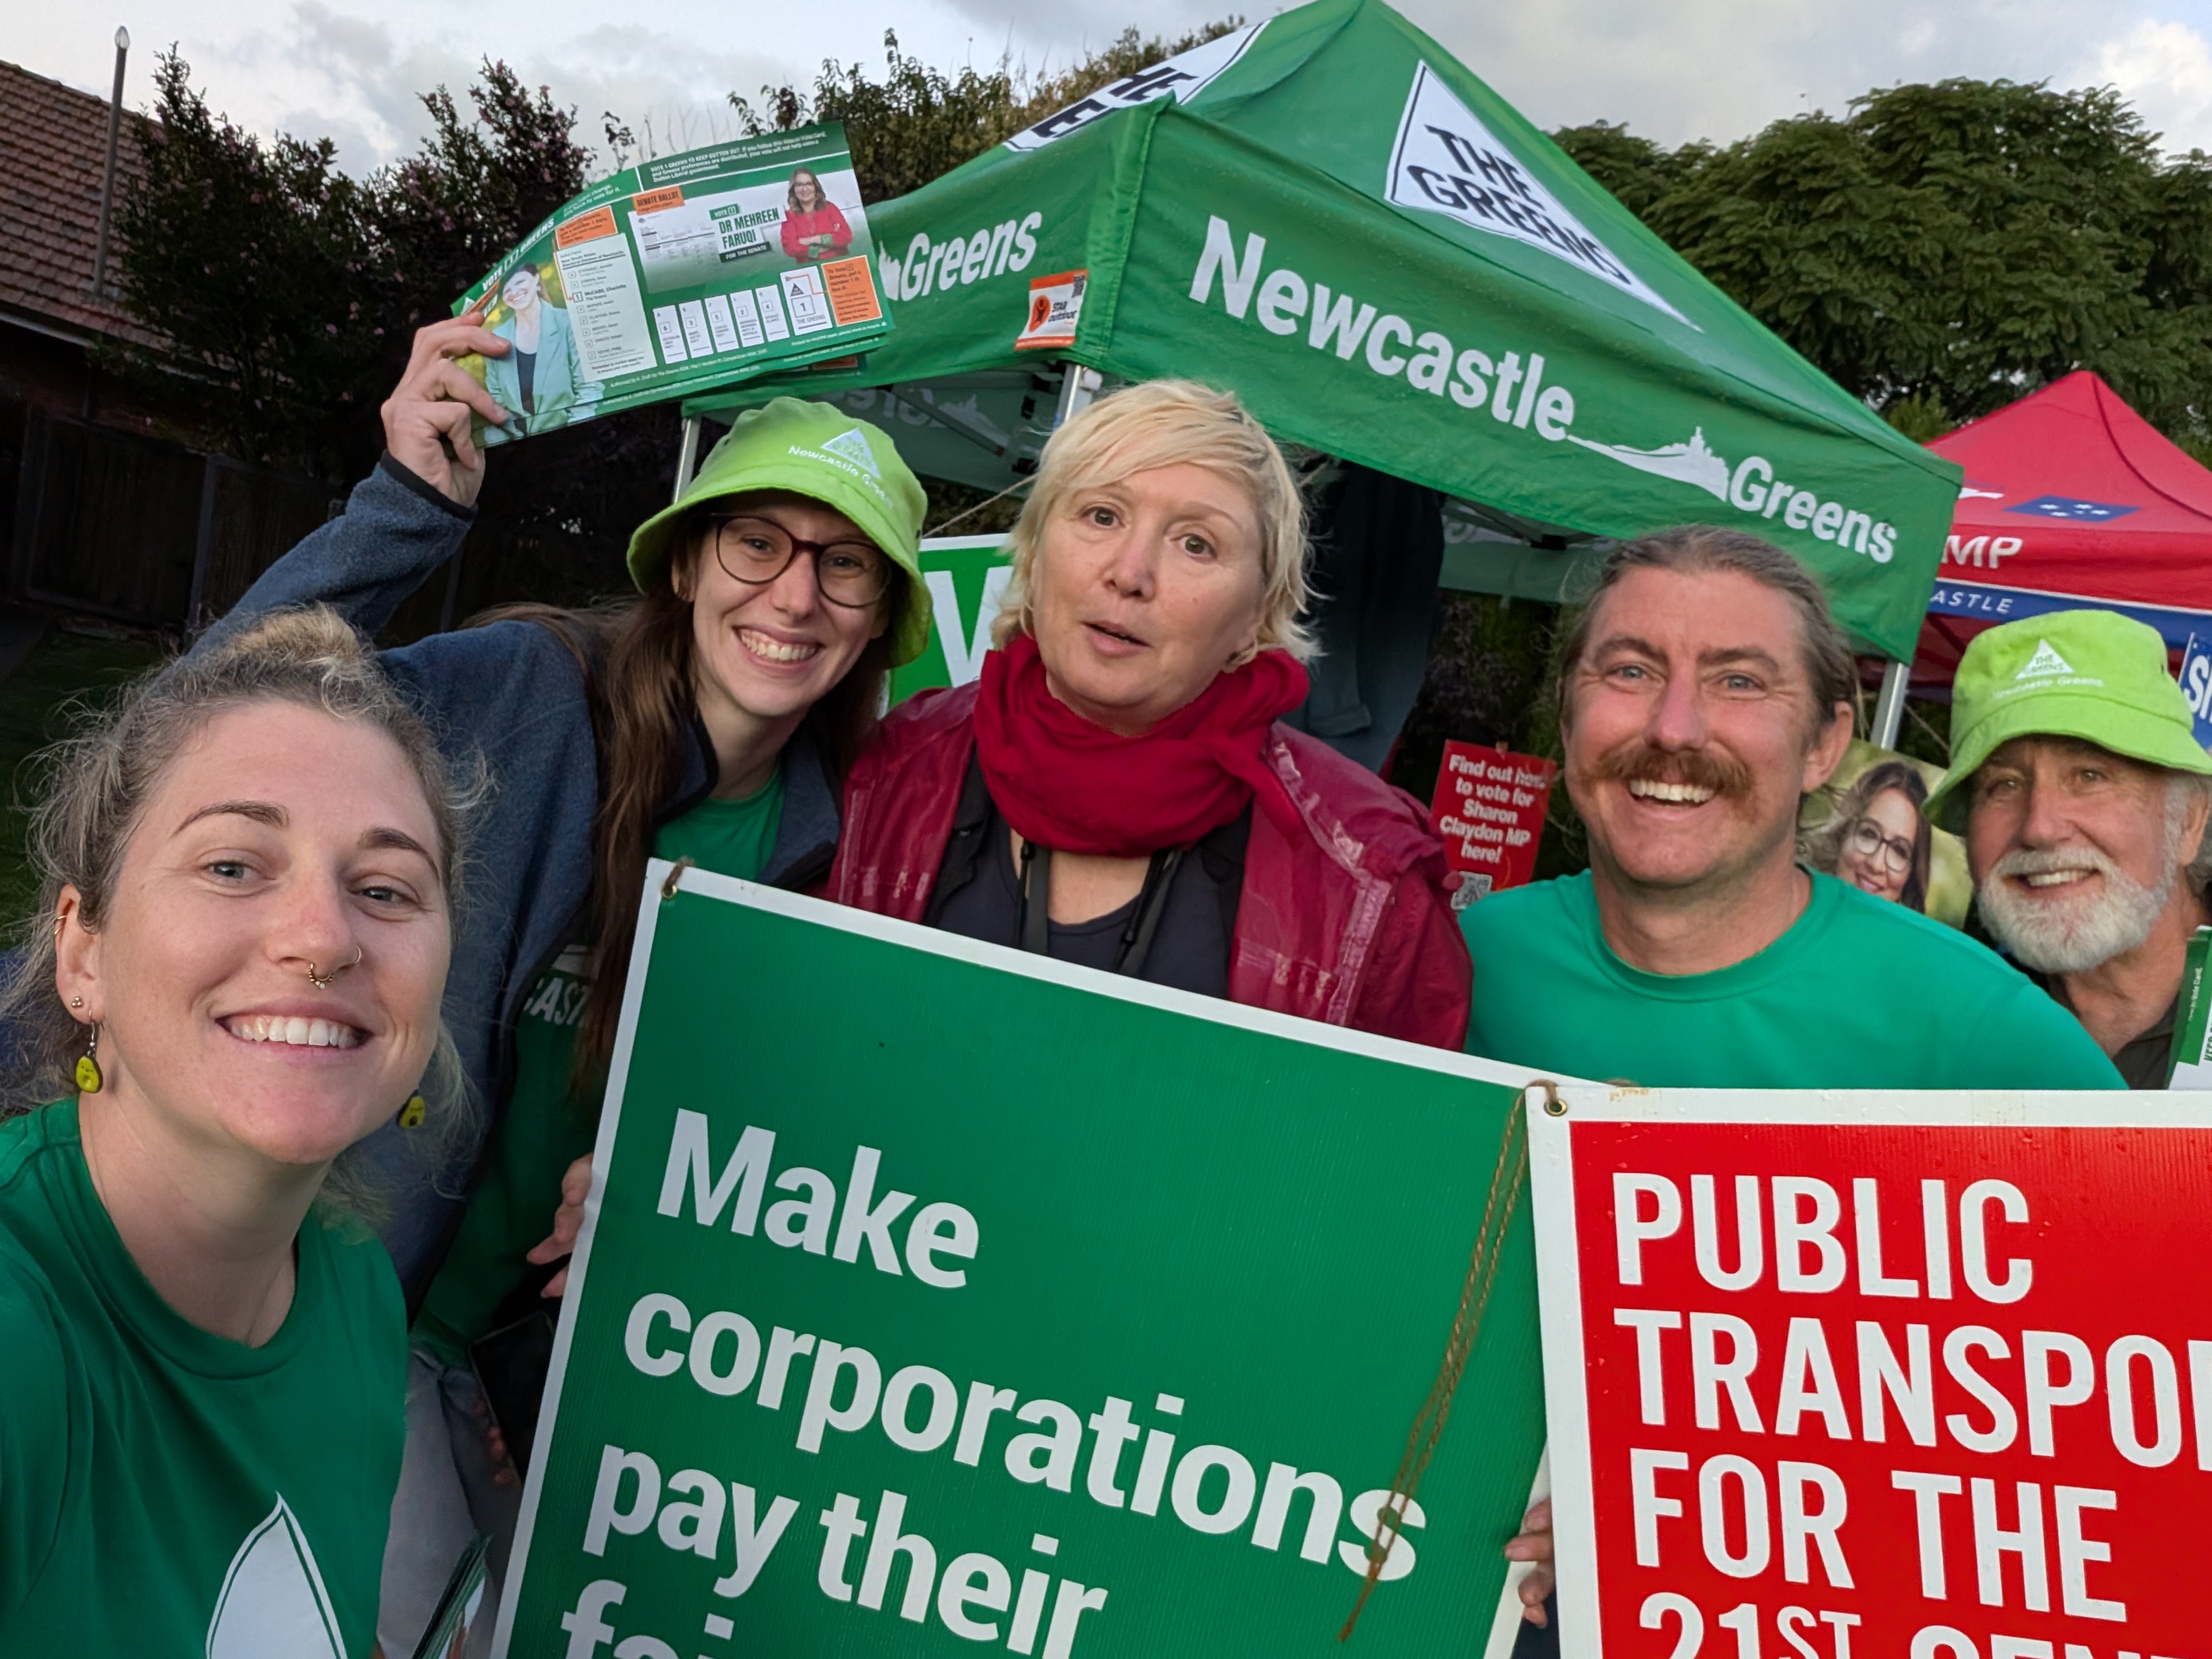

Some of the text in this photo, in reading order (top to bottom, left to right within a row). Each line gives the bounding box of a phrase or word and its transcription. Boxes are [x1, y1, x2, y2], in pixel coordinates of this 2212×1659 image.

[1424, 125, 1545, 211] THE
[719, 207, 780, 234] DR MEHREEN
[1407, 165, 1631, 285] GREENS
[722, 229, 757, 249] FARUQI
[901, 212, 1043, 301] Greens
[481, 266, 504, 291] VOTE
[800, 303, 806, 312] 1
[1189, 215, 1574, 443] Newcastle
[788, 445, 859, 477] Newcastle
[1728, 455, 1898, 564] Greens
[1940, 534, 2023, 569] MP
[1449, 754, 1486, 778] Find
[1487, 765, 1512, 783] out
[1455, 777, 1535, 807] to vote for
[1463, 798, 1518, 825] Sharon
[1439, 815, 1532, 848] Claydon MP
[1460, 839, 1503, 864] here!
[656, 1107, 980, 1289] Make
[1612, 1172, 2033, 1304] PUBLIC
[624, 1292, 1427, 1581] corporations
[583, 1444, 800, 1598] pay
[818, 1489, 1109, 1659] their
[1629, 1447, 2127, 1623] FOR THE
